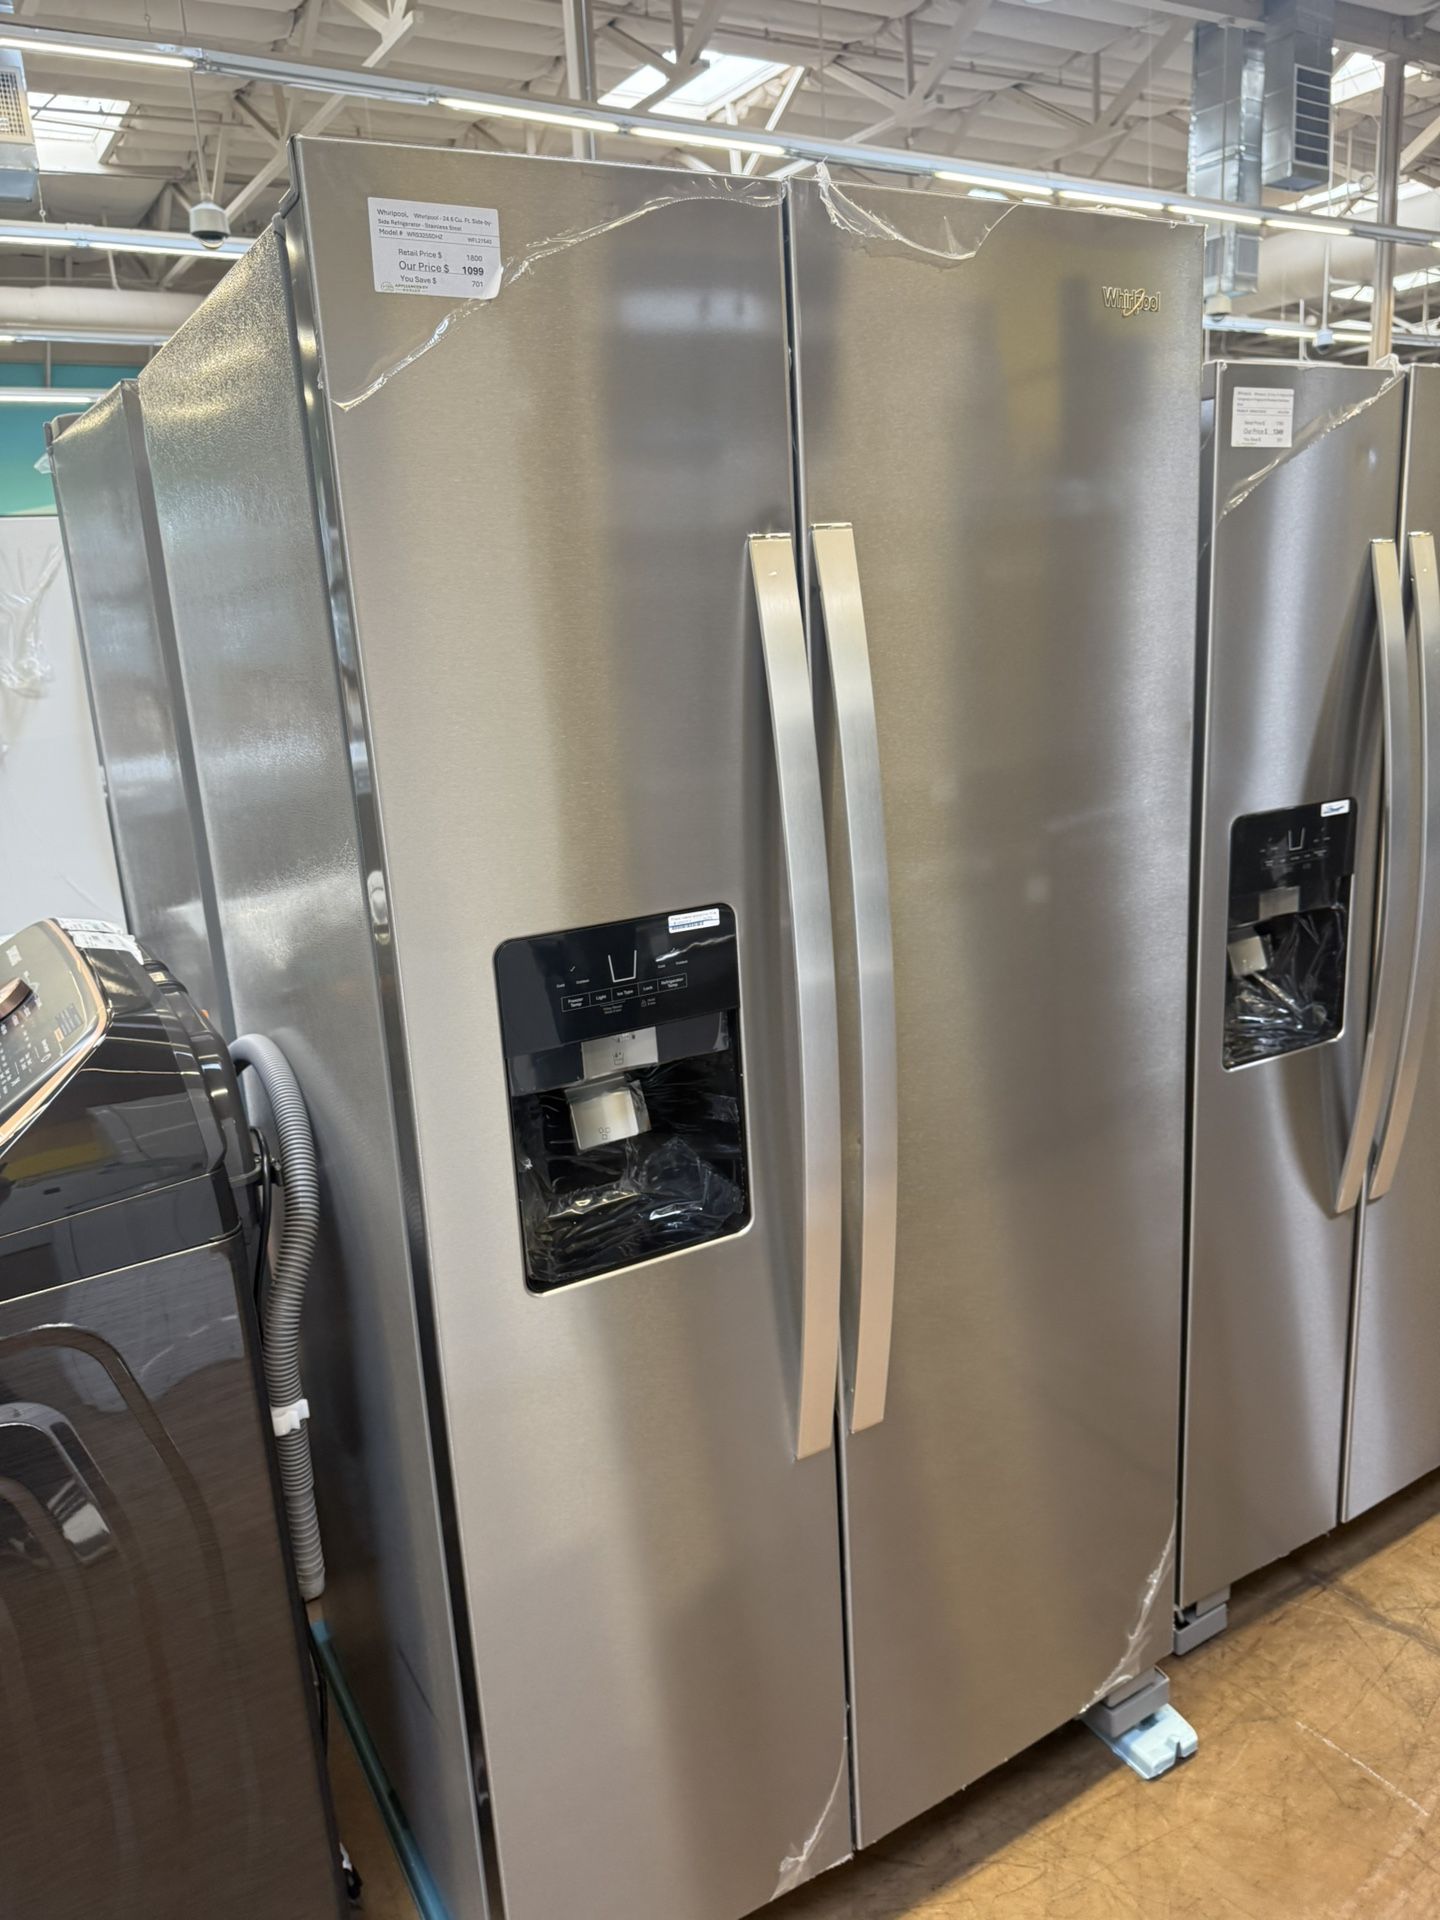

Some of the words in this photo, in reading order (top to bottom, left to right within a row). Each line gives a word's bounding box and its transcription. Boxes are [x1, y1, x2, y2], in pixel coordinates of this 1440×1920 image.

[379, 228, 397, 236] Model
[398, 248, 418, 257] Retail
[419, 250, 437, 259] Price
[438, 251, 442, 259] $
[467, 254, 483, 262] 1800
[398, 260, 416, 271] Our
[418, 262, 442, 273] Price
[444, 264, 450, 274] $
[462, 266, 484, 276] 1099
[400, 275, 414, 283] You
[415, 276, 431, 284] Save
[432, 277, 437, 285] $
[472, 280, 483, 288] 701
[1102, 285, 1160, 317] Whirlpool
